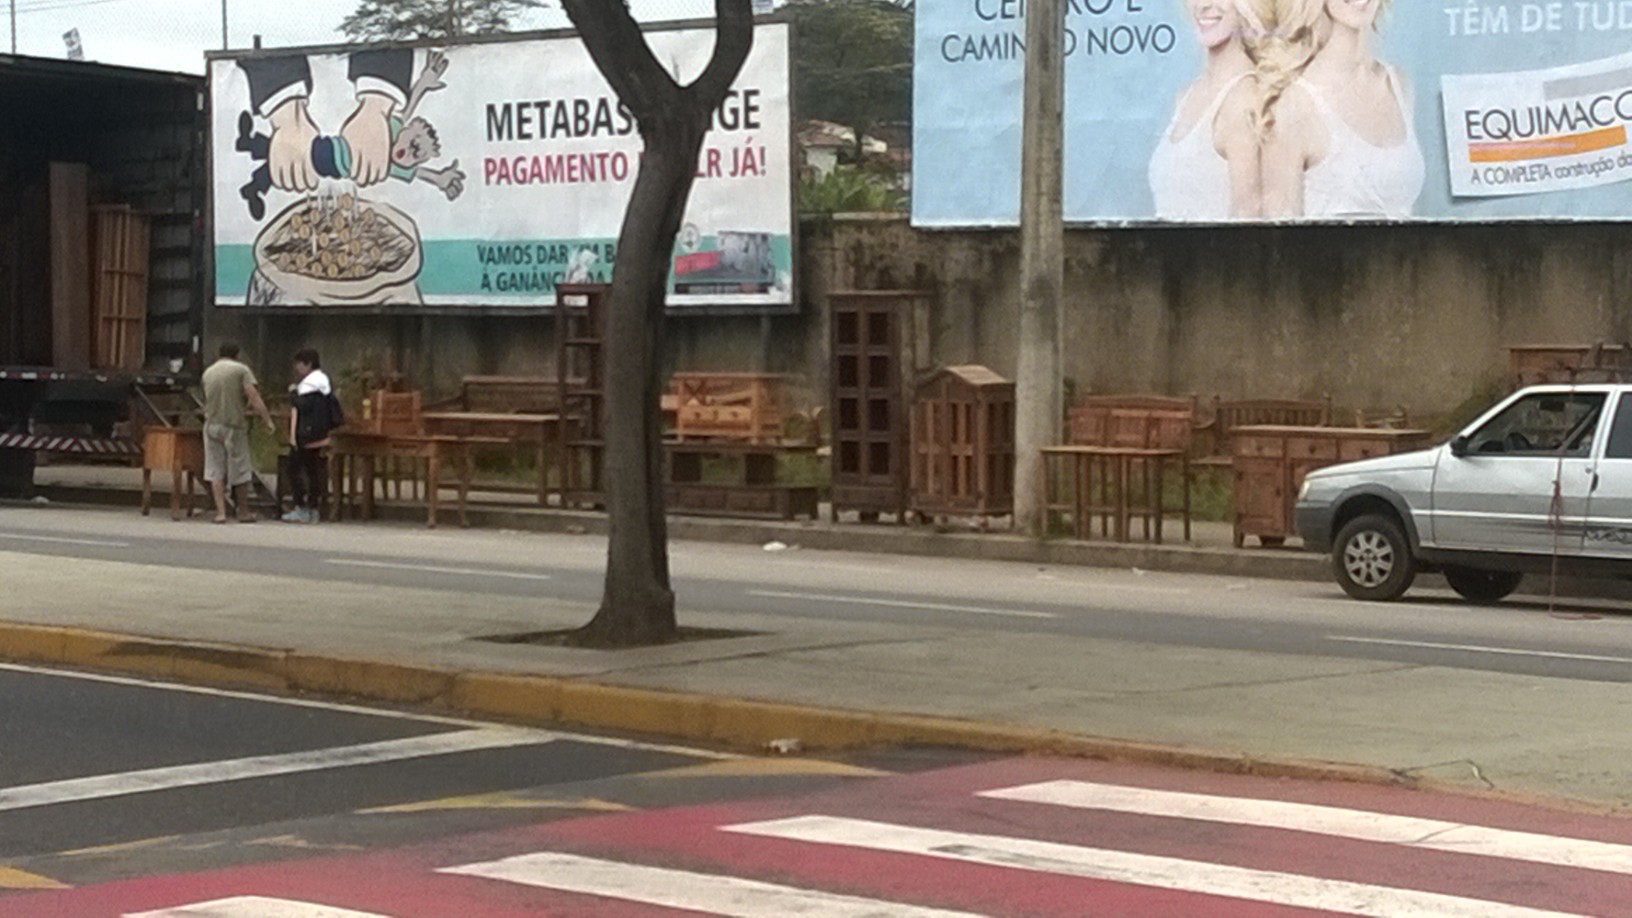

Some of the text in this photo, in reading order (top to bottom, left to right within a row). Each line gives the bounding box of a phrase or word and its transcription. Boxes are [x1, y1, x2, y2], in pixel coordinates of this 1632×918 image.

[1444, 0, 1509, 36] TÊM
[1521, 3, 1562, 33] DE
[941, 24, 1176, 63] CAMINO NOVO
[486, 97, 642, 142] METABAS
[484, 151, 628, 186] PAGAMENTO
[729, 136, 766, 178] JÁ!
[1471, 169, 1481, 184] A
[1484, 163, 1551, 186] COMPLETA
[477, 244, 533, 265] VAMOS
[537, 244, 569, 264] DAR
